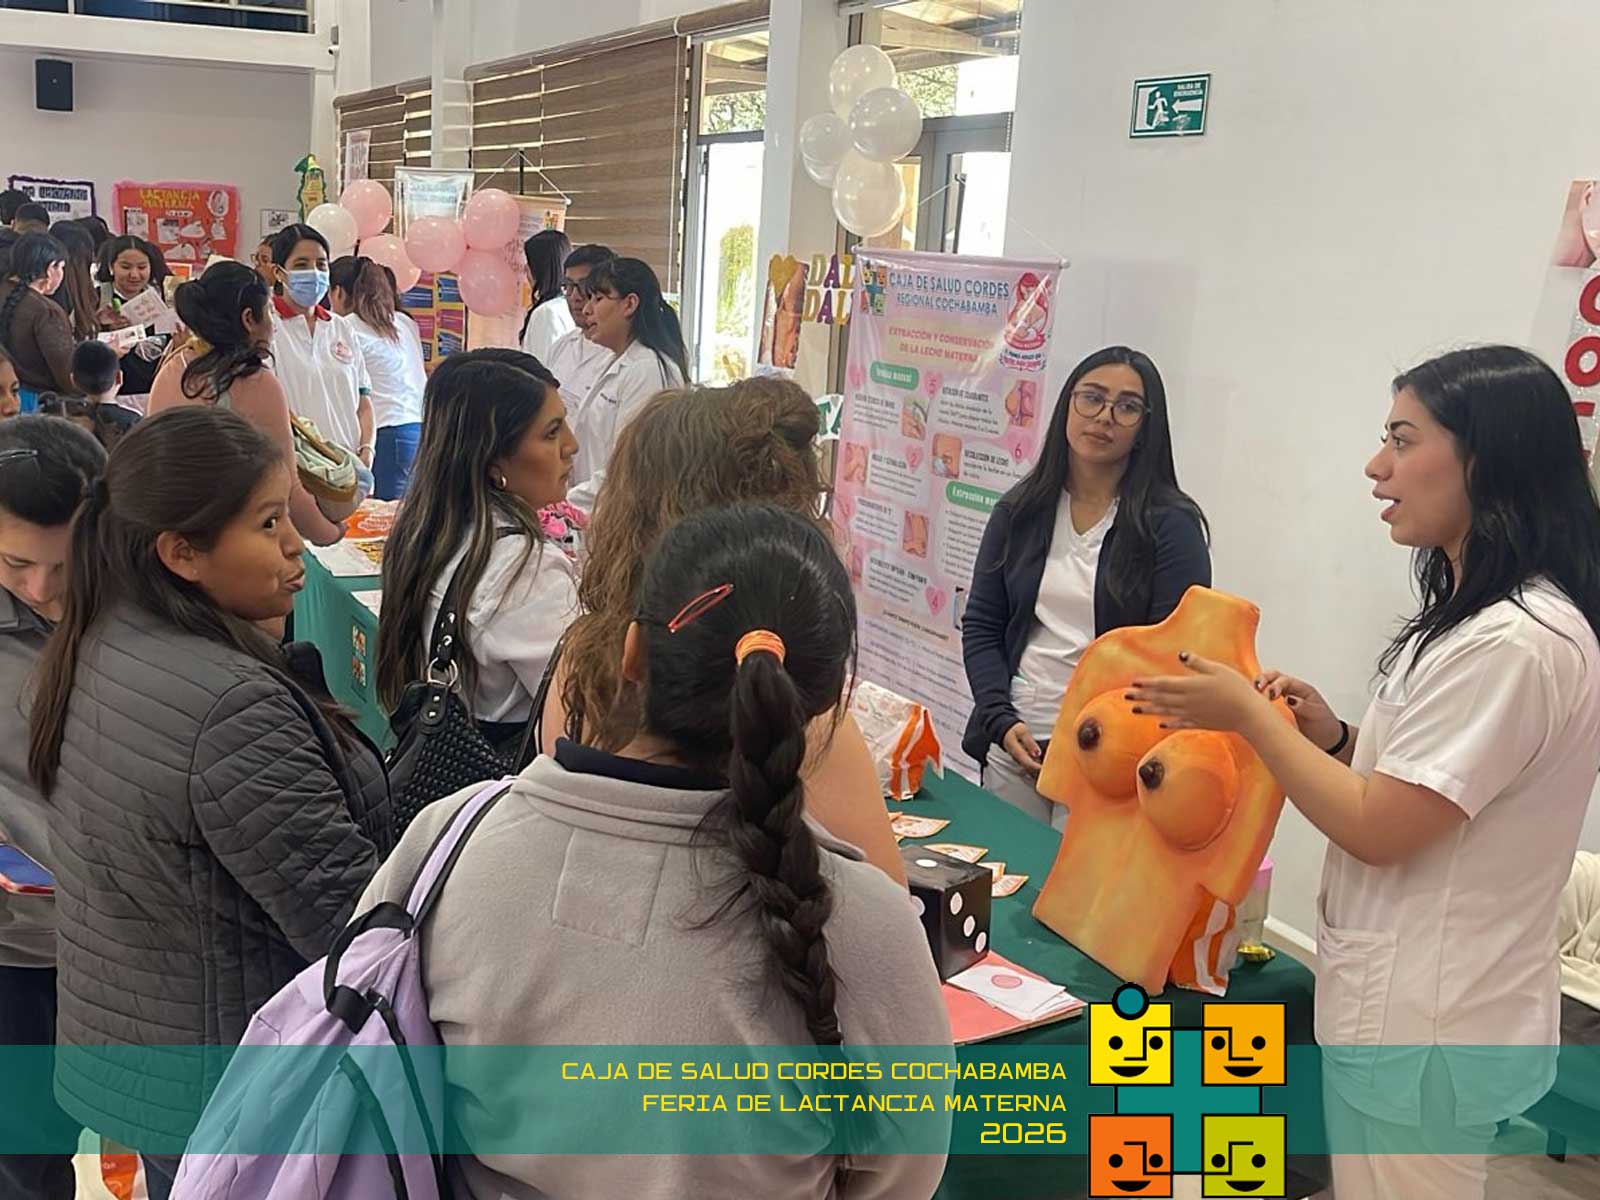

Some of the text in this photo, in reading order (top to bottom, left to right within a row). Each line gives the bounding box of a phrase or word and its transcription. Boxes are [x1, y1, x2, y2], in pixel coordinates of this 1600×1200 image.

[889, 272, 1009, 297] CAJA DE SALUD CORDES
[896, 293, 998, 314] REGIONAL COCHABAMBA
